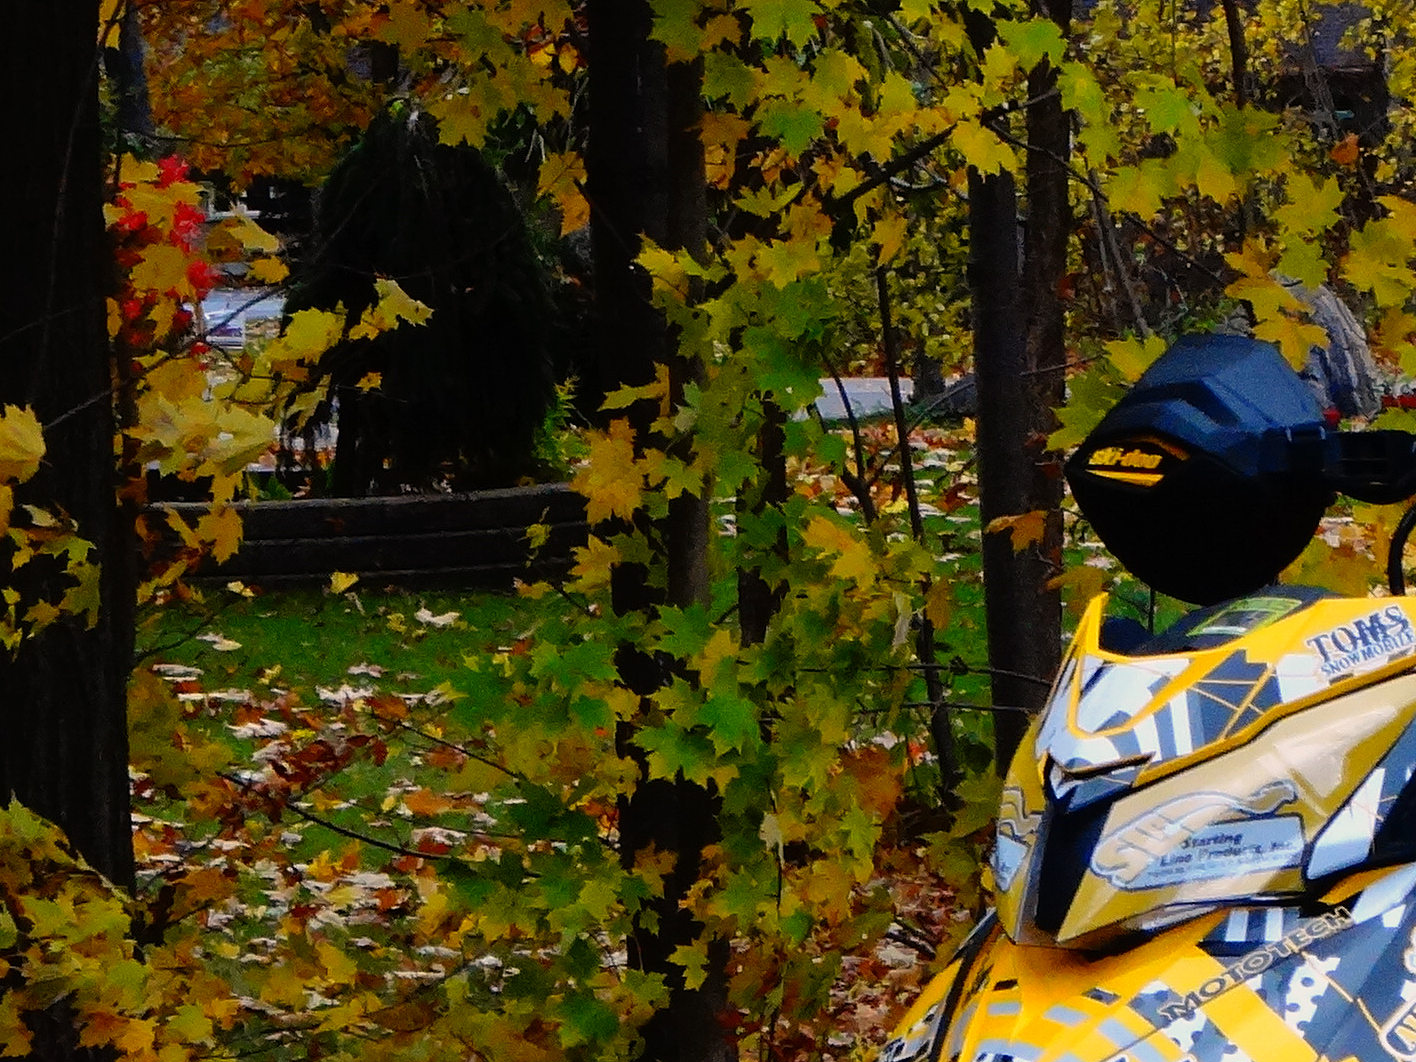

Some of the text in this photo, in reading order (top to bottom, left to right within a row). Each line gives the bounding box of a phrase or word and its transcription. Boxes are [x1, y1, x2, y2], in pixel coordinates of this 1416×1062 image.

[1306, 604, 1410, 663] TOMS
[1320, 628, 1415, 677] SNOWMOBILE
[1157, 906, 1355, 1021] MOTOTECH
